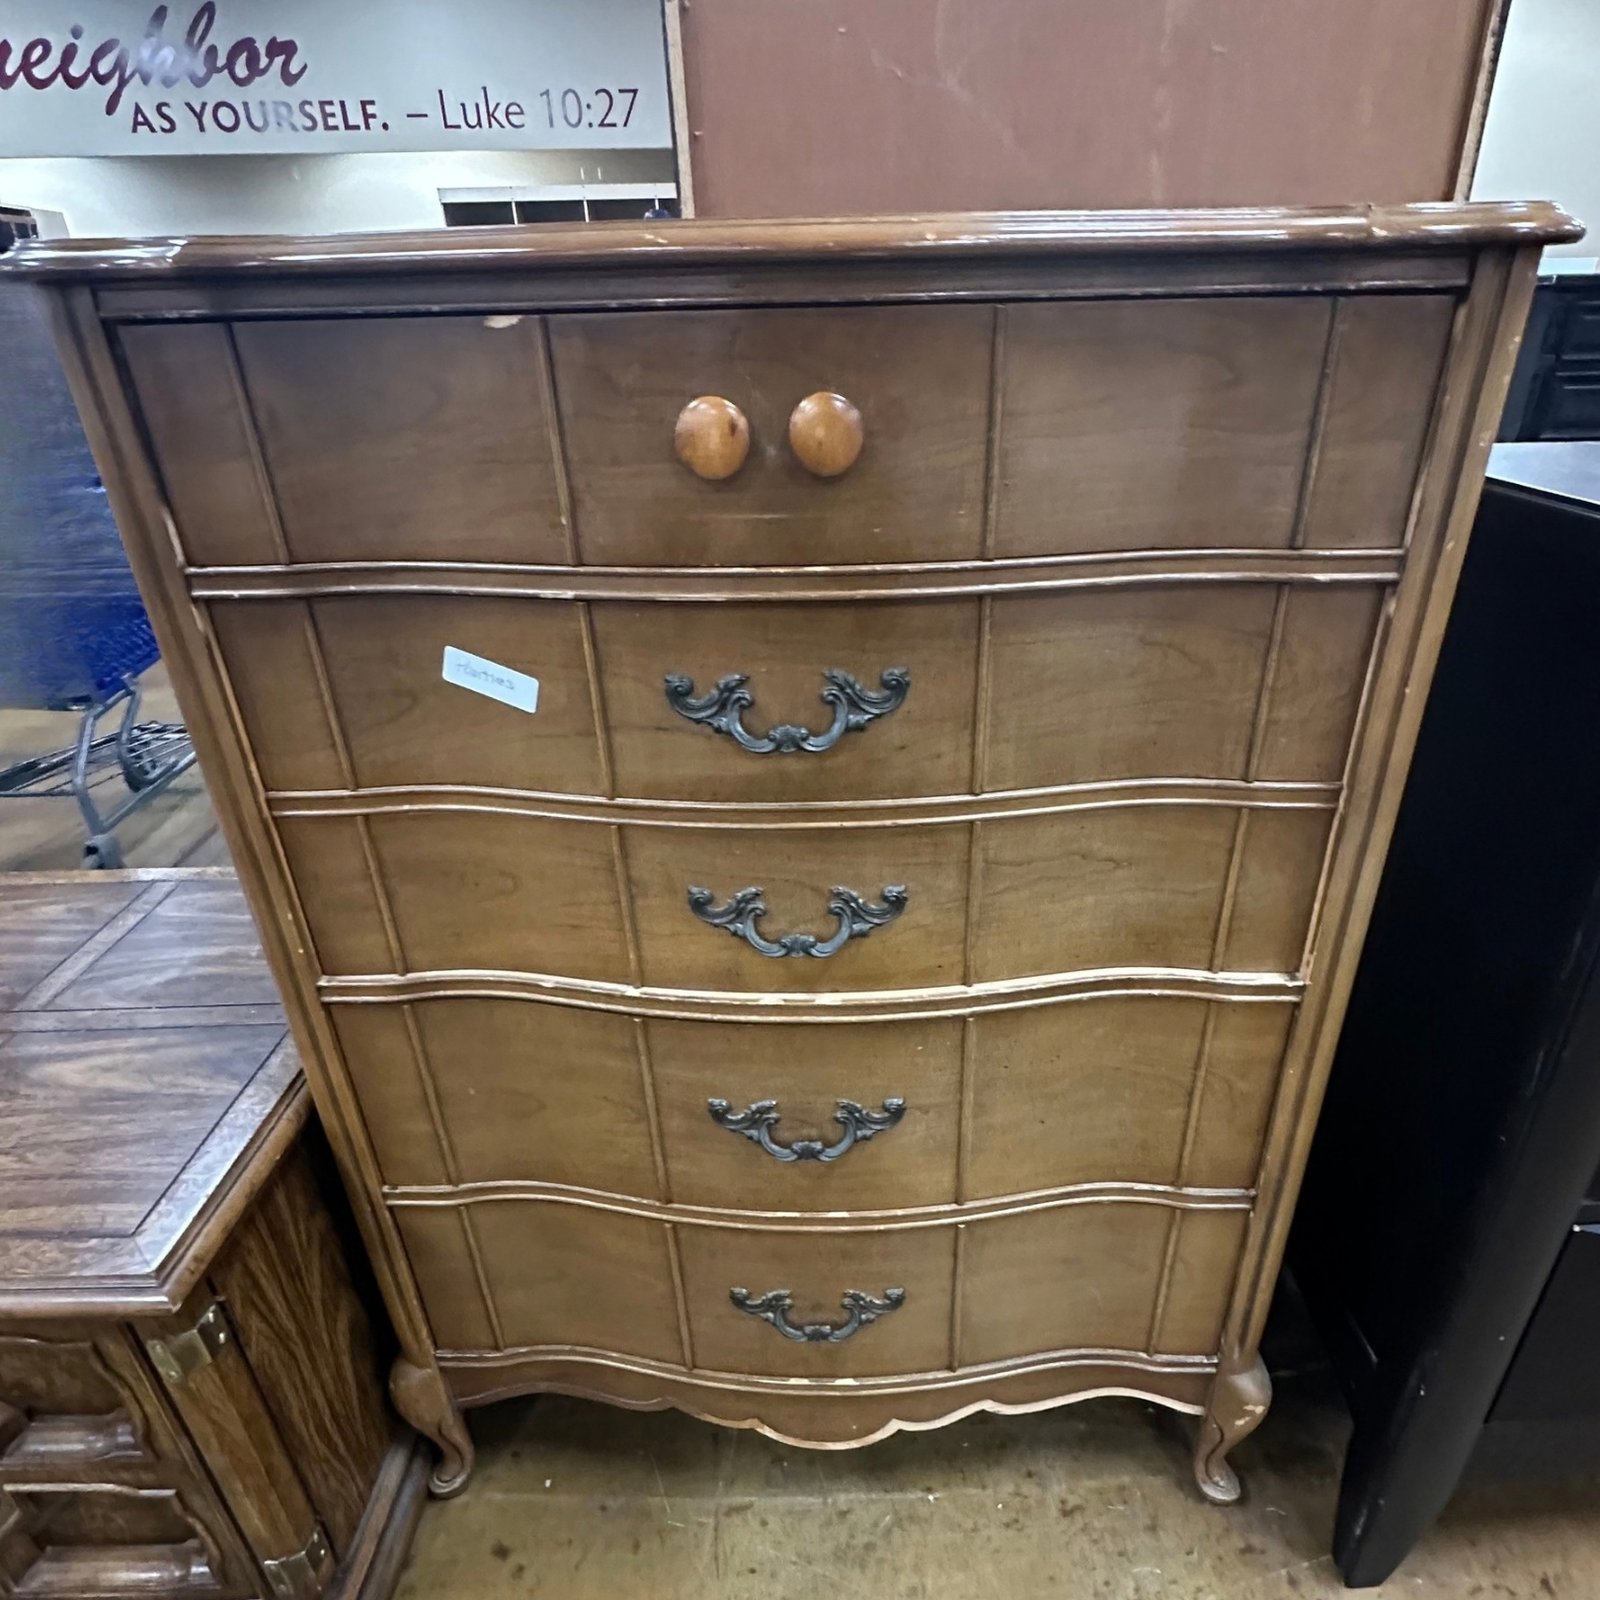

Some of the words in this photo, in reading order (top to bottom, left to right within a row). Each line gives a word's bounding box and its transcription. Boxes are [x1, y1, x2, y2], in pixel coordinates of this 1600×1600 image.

[131, 101, 177, 134] AS
[184, 99, 389, 133] YOURSELF.
[438, 86, 525, 129] Luke
[539, 87, 639, 129] 10:27
